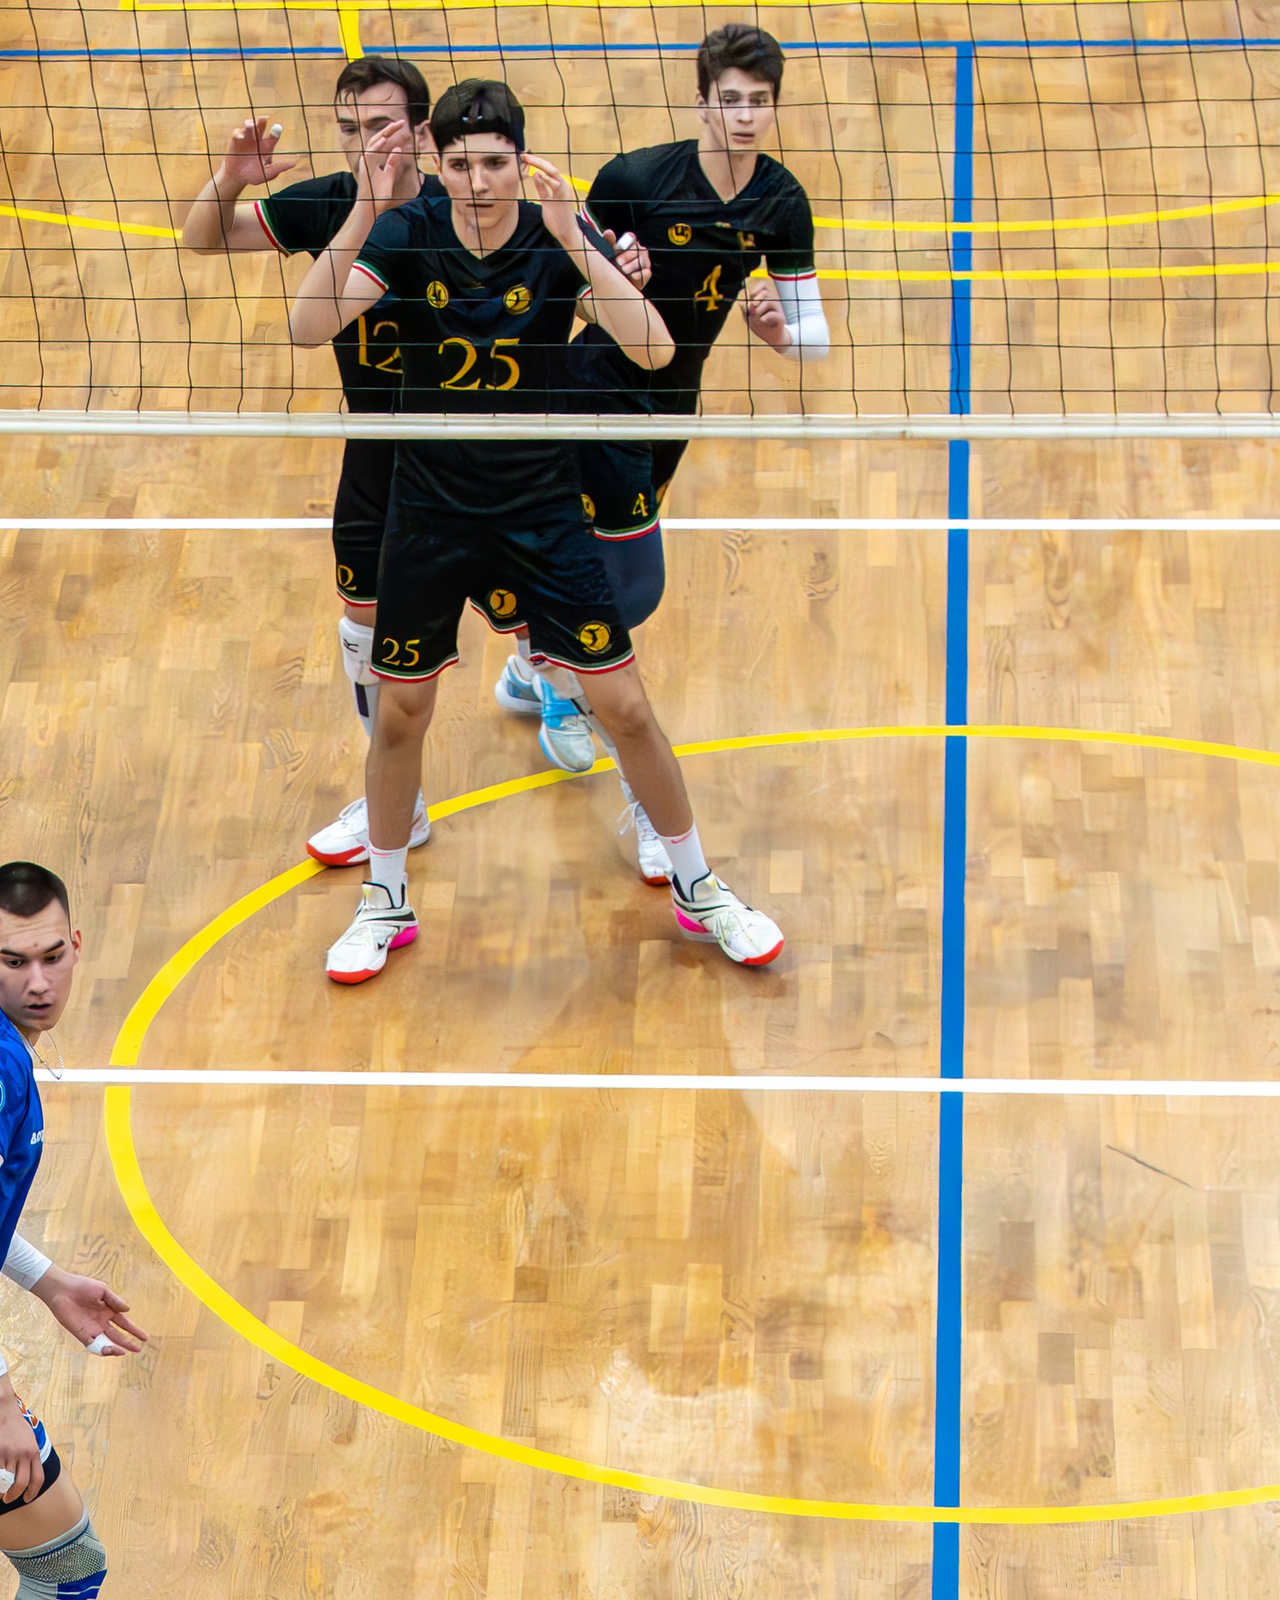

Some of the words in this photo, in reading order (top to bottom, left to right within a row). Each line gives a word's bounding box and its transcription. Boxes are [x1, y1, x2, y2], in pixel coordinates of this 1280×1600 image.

[695, 264, 724, 311] 4
[358, 314, 404, 374] 12
[438, 337, 520, 391] 25
[632, 492, 649, 517] 4
[382, 637, 420, 667] 25
